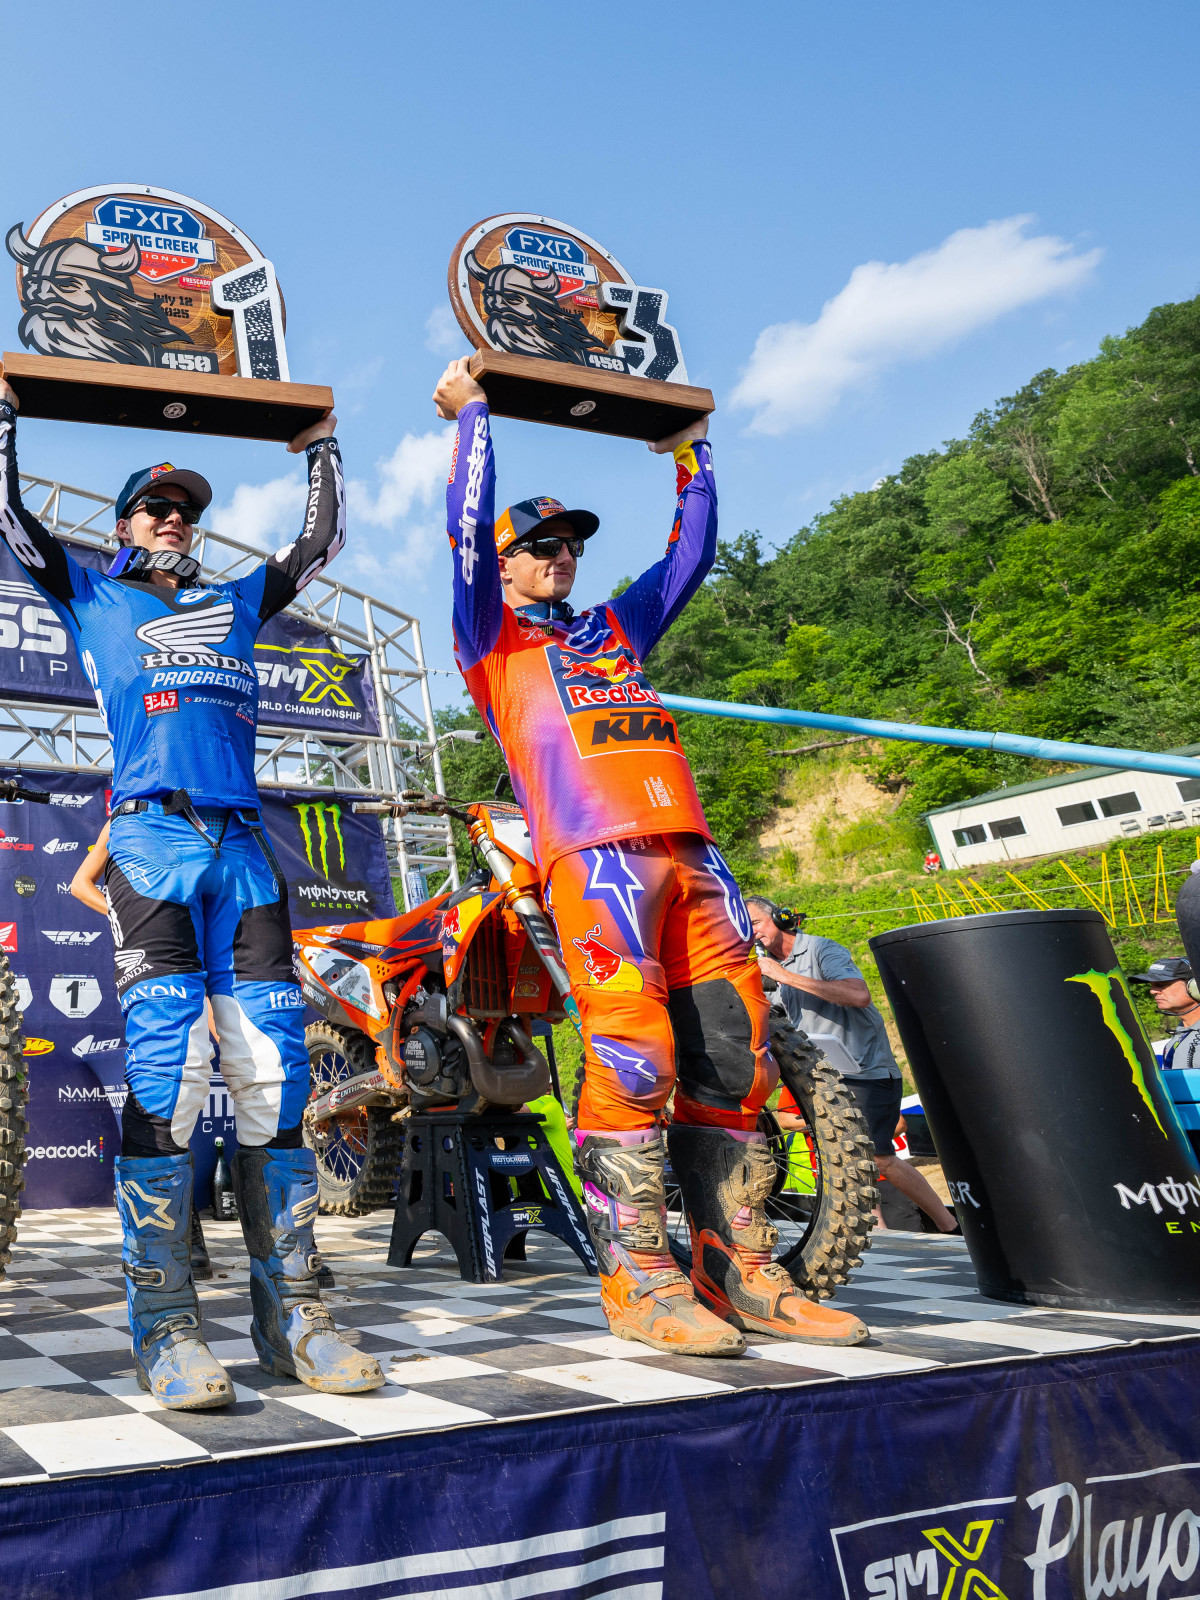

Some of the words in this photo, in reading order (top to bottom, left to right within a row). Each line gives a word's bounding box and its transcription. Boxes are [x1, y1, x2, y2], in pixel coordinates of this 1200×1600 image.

[114, 205, 184, 233] FXR
[155, 237, 200, 254] CREEK
[518, 233, 572, 258] FXR
[512, 254, 550, 270] SPRING
[552, 262, 586, 277] CREEK
[179, 296, 194, 307] 12
[163, 308, 190, 319] 025
[211, 259, 290, 382] 1
[601, 282, 687, 384] 3
[161, 352, 212, 373] 450
[588, 354, 625, 372] 450
[300, 458, 322, 540] HONDA
[458, 414, 488, 586] alpinestars
[142, 652, 256, 680] HONDA
[152, 671, 255, 696] PROGRESSIVE
[255, 657, 354, 708] SMX
[144, 691, 176, 711] ヨシムラ
[194, 696, 236, 708] DUNLOP
[566, 684, 628, 708] Red
[258, 700, 282, 712] ORLD
[285, 704, 362, 720] CHAMPIONSHIP
[591, 712, 676, 746] KTM
[50, 794, 93, 804] FLY
[56, 842, 79, 850] UFO
[298, 885, 370, 904] MONSTER
[311, 902, 360, 910] ENERGY
[49, 930, 102, 942] FLY
[116, 963, 154, 990] HONDA
[66, 980, 86, 1008] 1ST
[90, 1038, 120, 1050] UFO
[476, 1167, 498, 1278] UFOPLAST
[513, 1210, 543, 1224] SMX
[864, 1518, 1008, 1600] SMX
